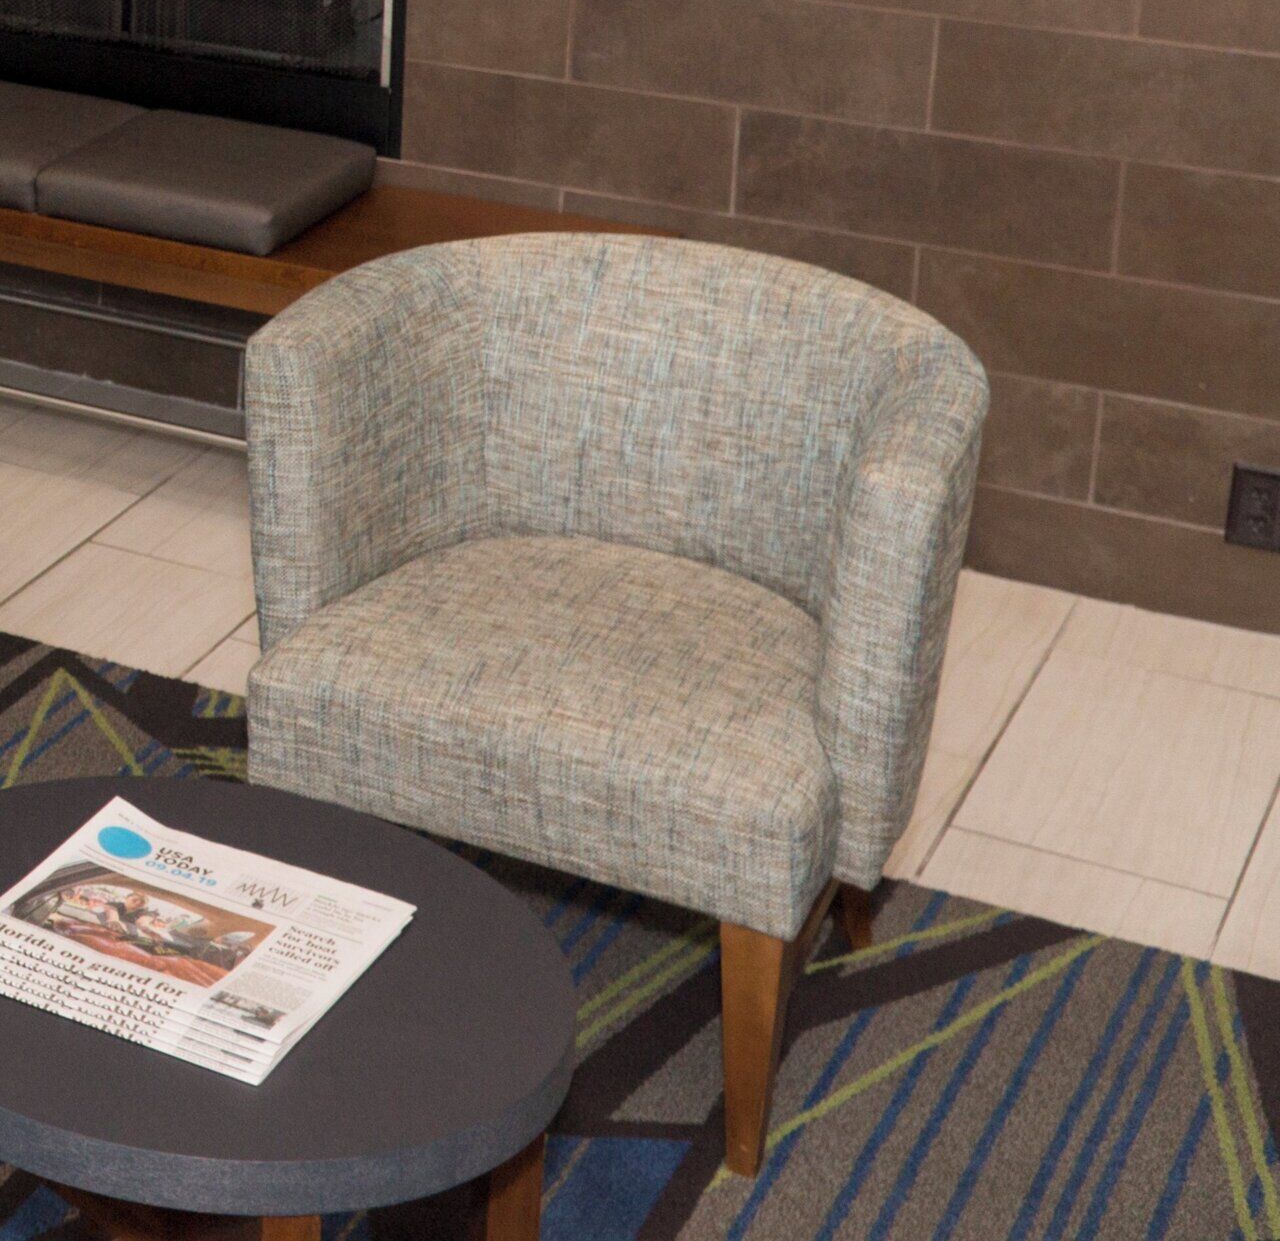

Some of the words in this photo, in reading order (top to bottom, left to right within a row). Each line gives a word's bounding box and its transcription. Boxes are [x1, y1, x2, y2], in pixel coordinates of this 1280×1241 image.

[153, 853, 214, 876] TODAY
[159, 847, 194, 863] USA
[145, 860, 217, 886] 09.04.19
[282, 932, 301, 943] for
[305, 940, 336, 954] boat
[290, 925, 336, 945] Search
[269, 947, 312, 964] called
[314, 961, 334, 971] off
[276, 940, 340, 965] survivors
[60, 948, 85, 964] on
[87, 959, 152, 985] guard
[156, 981, 188, 998] for
